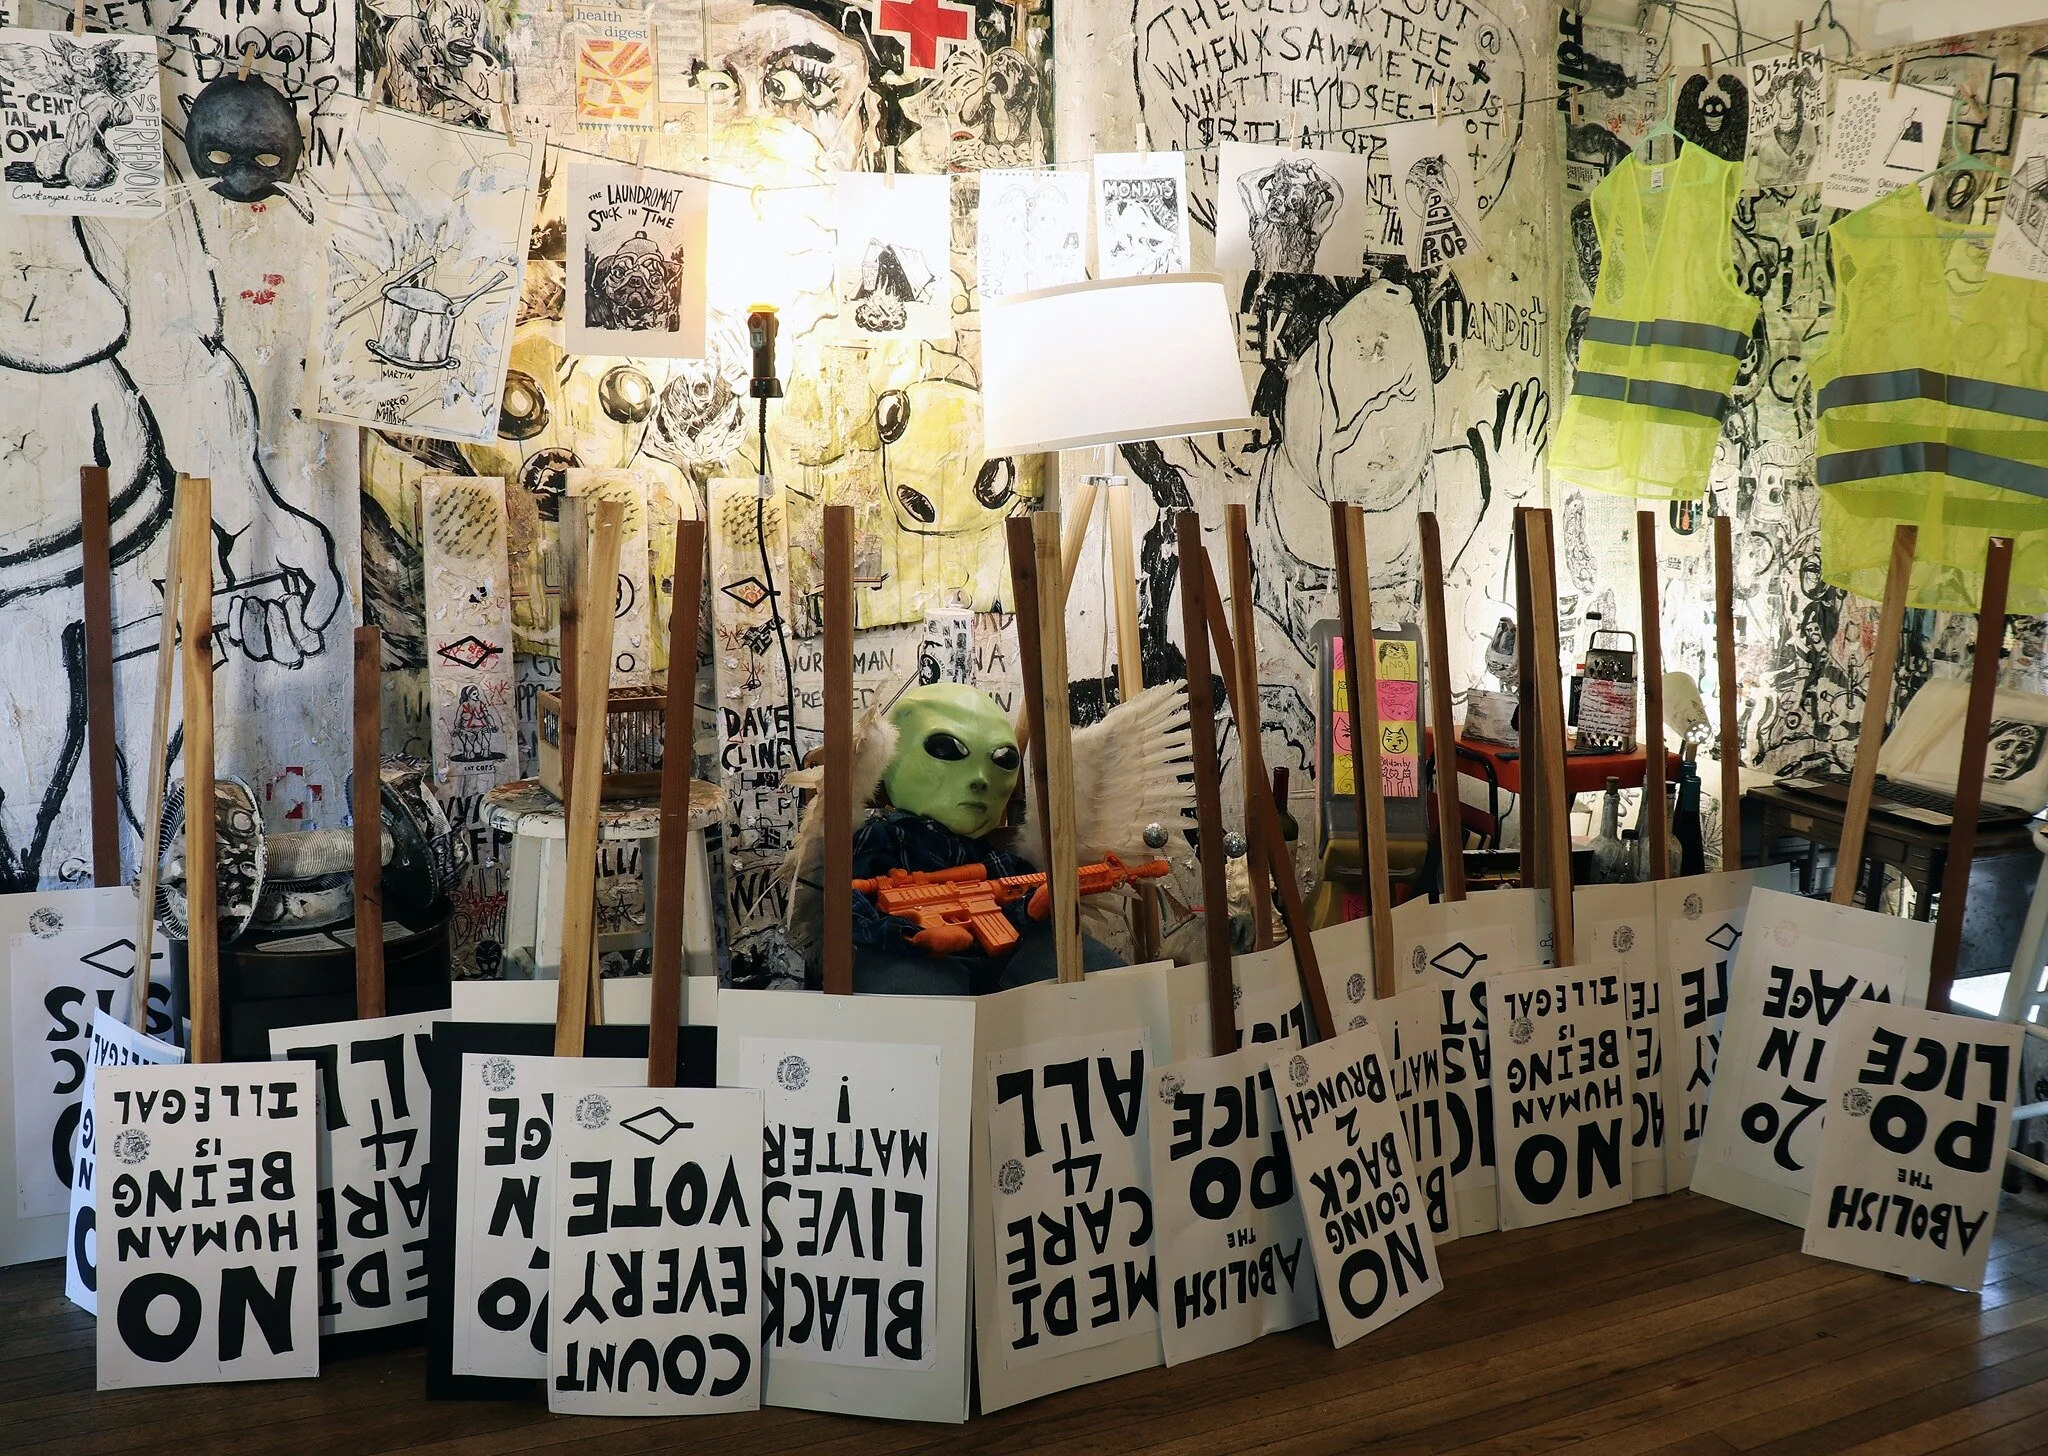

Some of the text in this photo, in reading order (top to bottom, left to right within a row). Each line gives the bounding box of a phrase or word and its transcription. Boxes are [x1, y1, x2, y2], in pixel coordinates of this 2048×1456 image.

[576, 8, 622, 23] health
[604, 25, 649, 41] digest
[1380, 7, 1459, 69] TREE
[5, 119, 65, 153] OWL
[588, 184, 683, 214] THE LAUNDROMAT
[628, 208, 638, 216] IN
[1103, 180, 1175, 201] MONDAYS
[719, 704, 791, 741] DAVE
[1504, 975, 1619, 1018] ILLEGAL
[1507, 1029, 1619, 1094] BEING
[1558, 1023, 1575, 1041] IS
[1757, 1027, 1827, 1083] IN
[1858, 1027, 2010, 1103] LICE
[114, 1082, 298, 1125] ILLEGAL
[997, 1049, 1144, 1158] ALL
[1169, 1069, 1281, 1161] LICE
[1286, 1054, 1387, 1141] BRUNCH
[1335, 1107, 1360, 1147] 2
[1512, 1075, 1623, 1128] HUMAN
[1741, 1084, 1827, 1171] 20
[195, 1138, 221, 1158] IS
[361, 1099, 418, 1171] 4
[763, 1123, 927, 1180] MATTER
[1052, 1123, 1102, 1197] 4
[1514, 1117, 1622, 1205] NO
[1869, 1095, 1997, 1173] PO
[112, 1151, 294, 1217] BEING
[567, 1155, 750, 1237] VOTE
[1189, 1130, 1293, 1220] PO
[1309, 1132, 1403, 1219] BACK
[1898, 1168, 1934, 1191] THE
[117, 1210, 298, 1262] HUMAN
[762, 1181, 923, 1267] LIVES
[1006, 1186, 1153, 1285] CARE
[1226, 1226, 1256, 1249] THE
[1325, 1181, 1411, 1255] GOING
[1828, 1186, 1989, 1257] ABOLISH
[563, 1245, 748, 1324] EVERY
[1012, 1255, 1158, 1350] MEDI
[1174, 1237, 1302, 1329] ABOLISH
[1339, 1223, 1429, 1320] NO
[117, 1266, 297, 1363] NO
[762, 1267, 924, 1360] BLACK
[556, 1334, 750, 1397] COUNT
